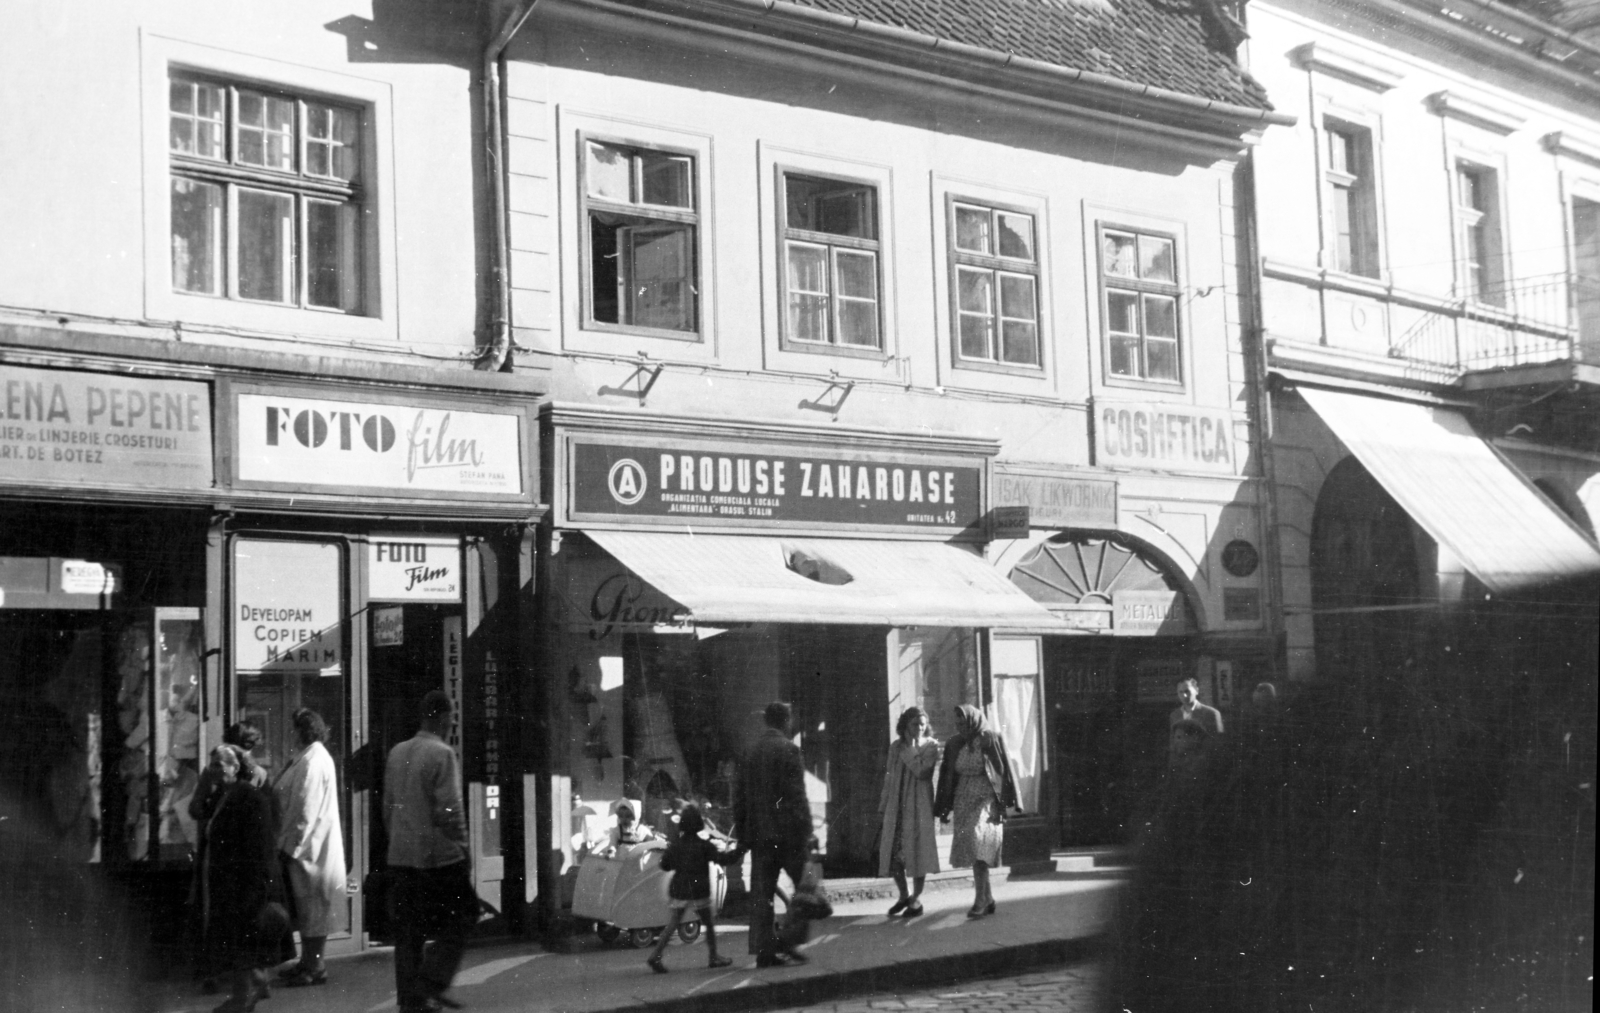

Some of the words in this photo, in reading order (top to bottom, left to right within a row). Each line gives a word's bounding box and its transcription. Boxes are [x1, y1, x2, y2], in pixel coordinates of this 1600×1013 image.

[0, 380, 70, 423] ENA
[87, 386, 200, 431] PEPENE
[0, 427, 23, 441] IER
[266, 406, 396, 453] FOTO
[406, 409, 483, 483] film
[1102, 408, 1231, 464] COSMETICA
[0, 445, 23, 459] RT.
[27, 446, 45, 461] DE
[53, 449, 103, 464] BOTEZ
[618, 466, 637, 495] A
[660, 454, 785, 495] PRODUSE
[800, 462, 955, 504] ZAHAROASE
[998, 478, 1031, 503] ISAK
[748, 507, 773, 516] STALIN
[945, 510, 956, 524] 42
[376, 541, 427, 563] FOTO
[405, 566, 450, 591] Film
[240, 604, 312, 622] DEVELOPAM
[254, 625, 323, 643] COPIEM
[267, 645, 336, 663] MARIM
